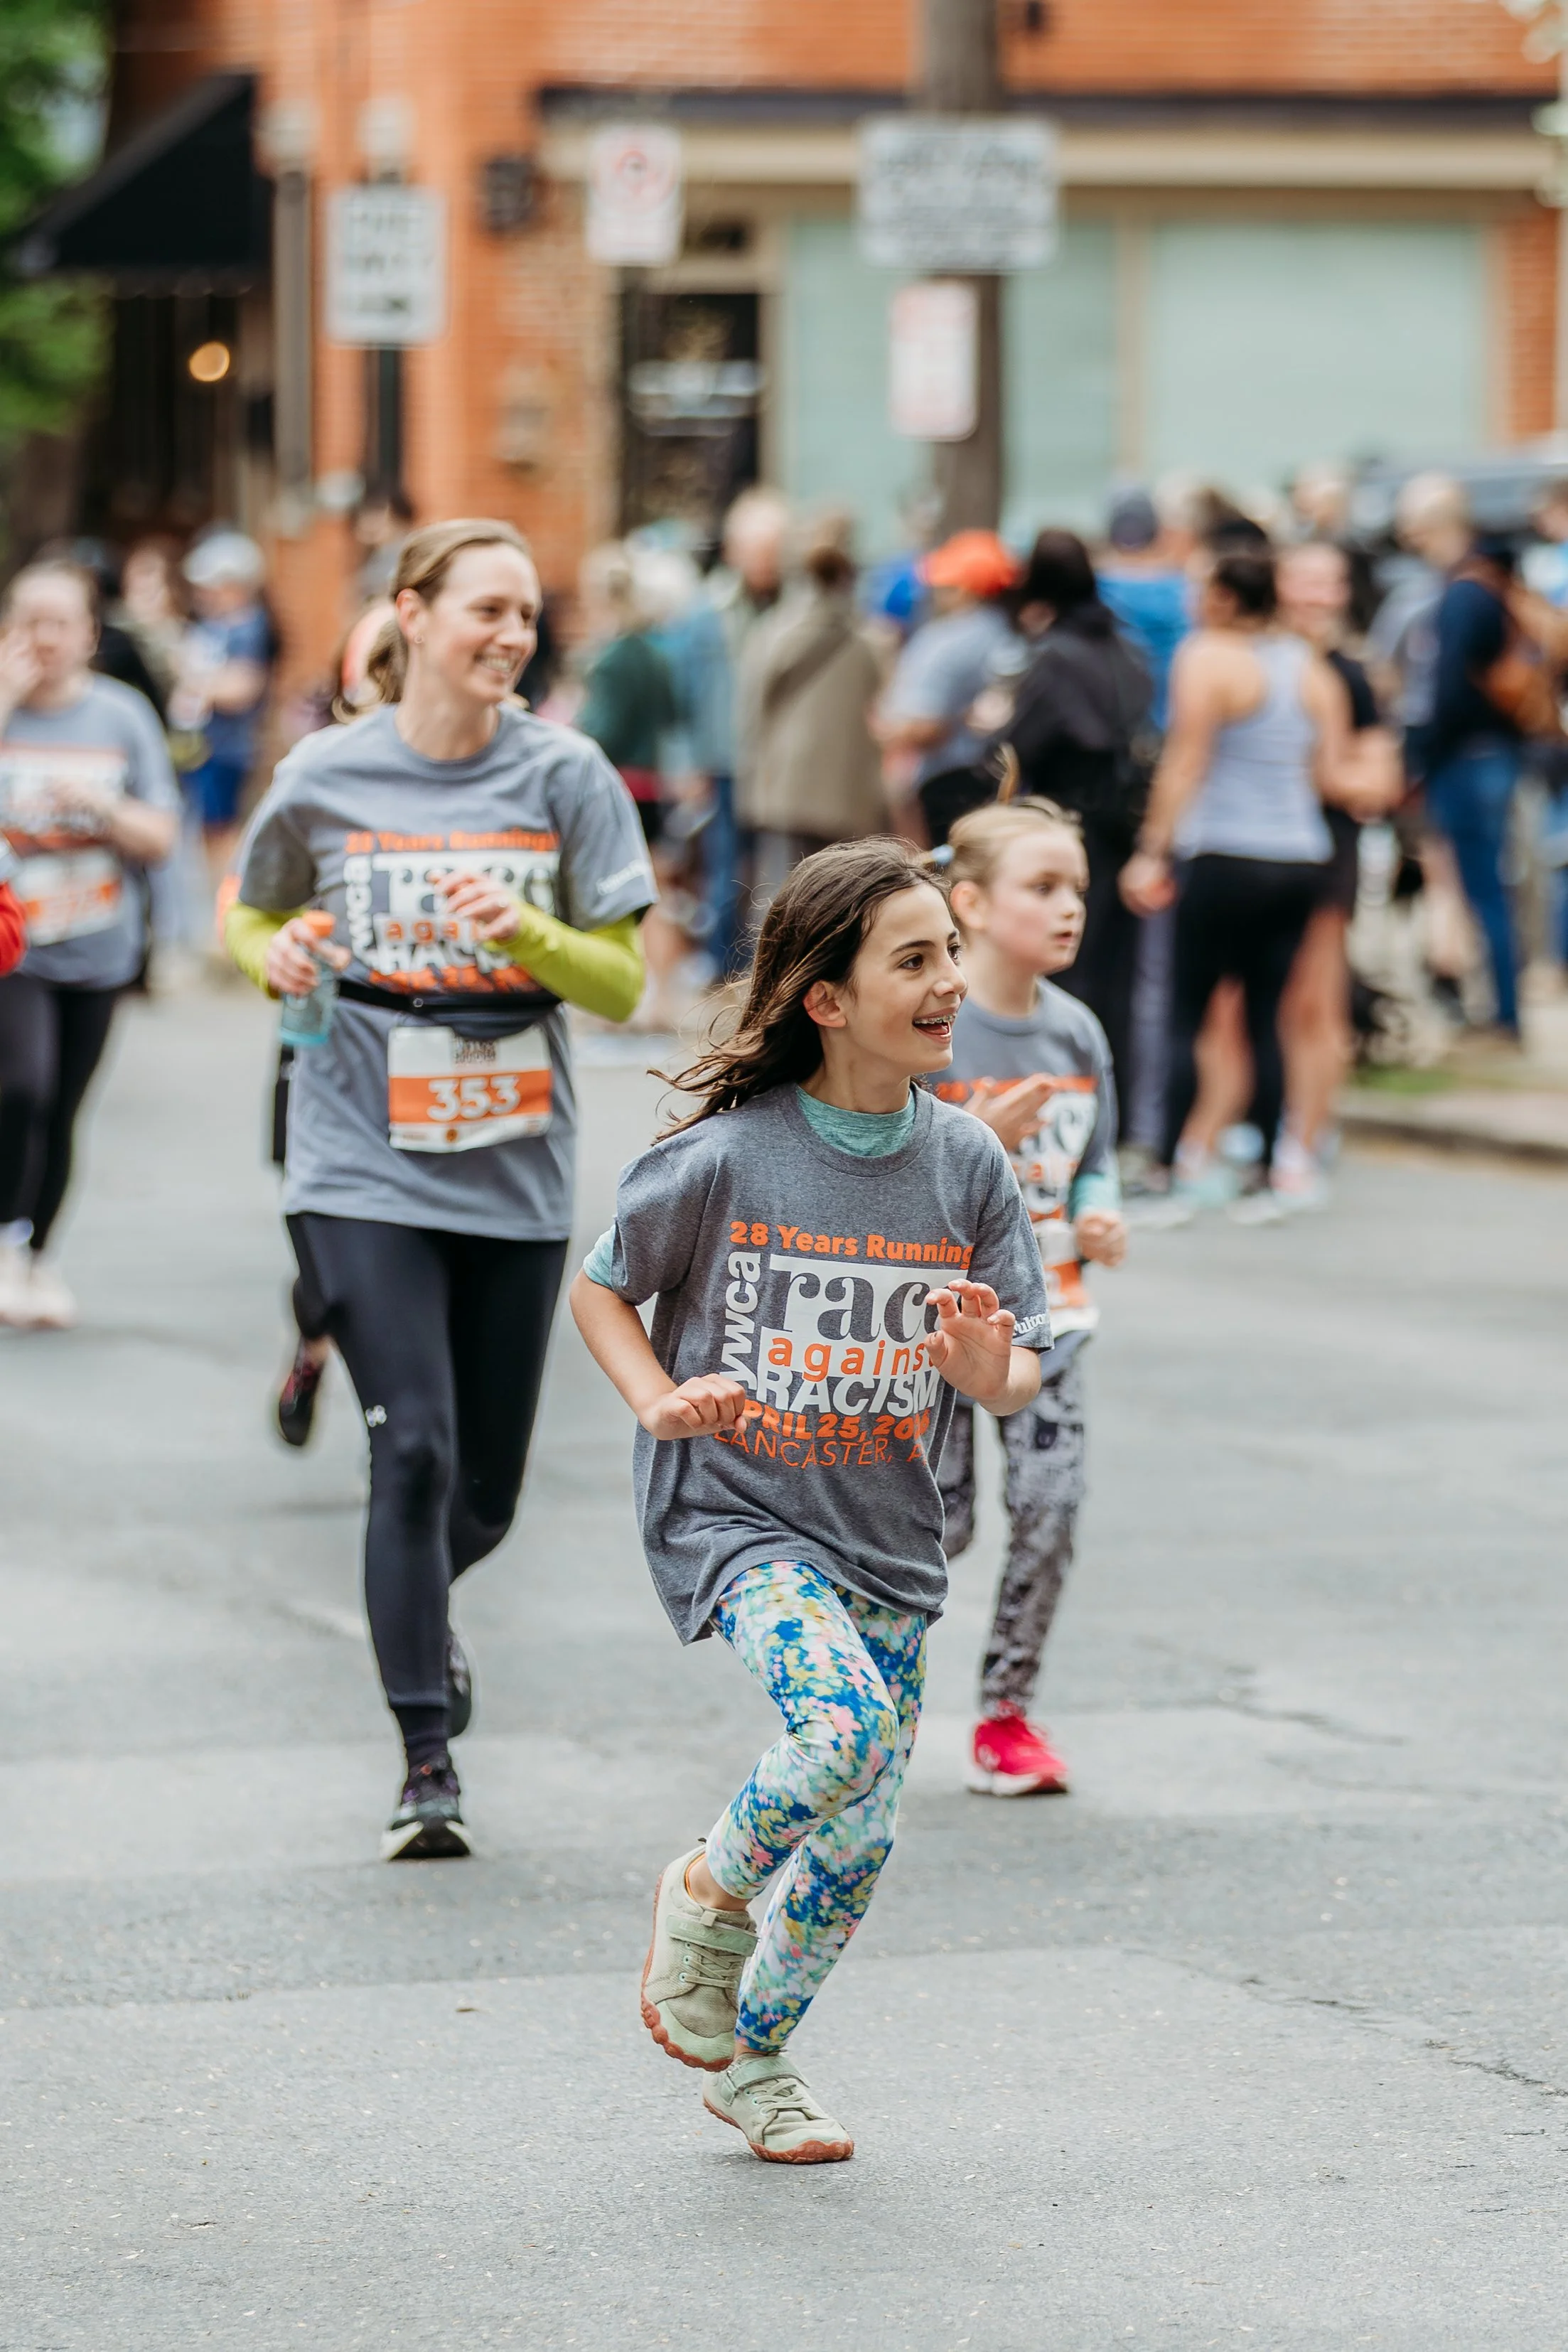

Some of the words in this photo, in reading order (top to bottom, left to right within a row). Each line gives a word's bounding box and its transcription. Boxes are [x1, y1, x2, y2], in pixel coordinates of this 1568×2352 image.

[426, 1075, 520, 1122] 353
[730, 1220, 769, 1246] 28
[776, 1225, 858, 1257] Years
[866, 1235, 975, 1269] Running
[719, 1251, 761, 1391] ywca
[756, 1368, 941, 1417] RACISM
[742, 1398, 812, 1440] PRIL
[817, 1412, 869, 1443] 25,
